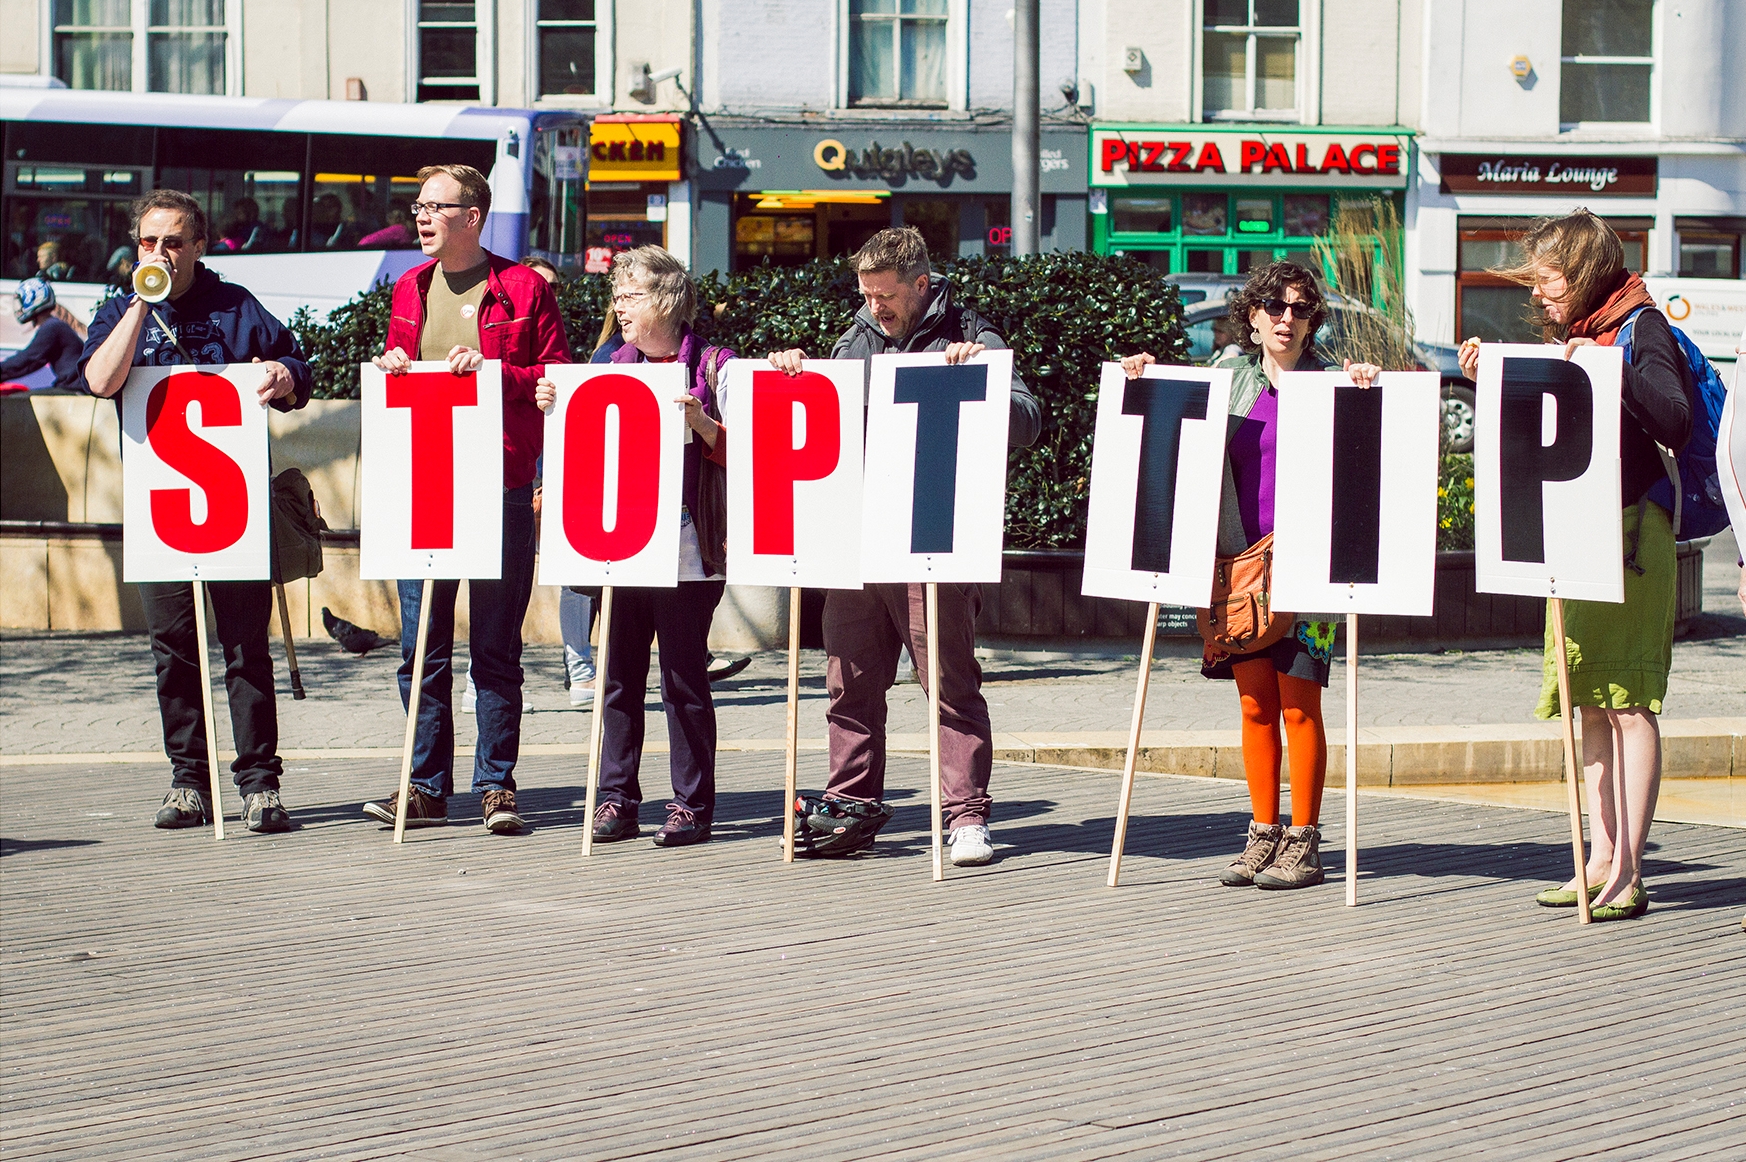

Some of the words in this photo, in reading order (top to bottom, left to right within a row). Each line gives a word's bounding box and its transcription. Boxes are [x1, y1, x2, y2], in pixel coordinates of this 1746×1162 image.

[813, 139, 977, 181] Quigleys
[1102, 139, 1227, 172] PIZZA
[1240, 140, 1400, 174] PALACE
[1477, 159, 1541, 182] Maria
[1544, 162, 1619, 191] Lounge
[1167, 620, 1188, 628] objects
[1169, 613, 1181, 621] may
